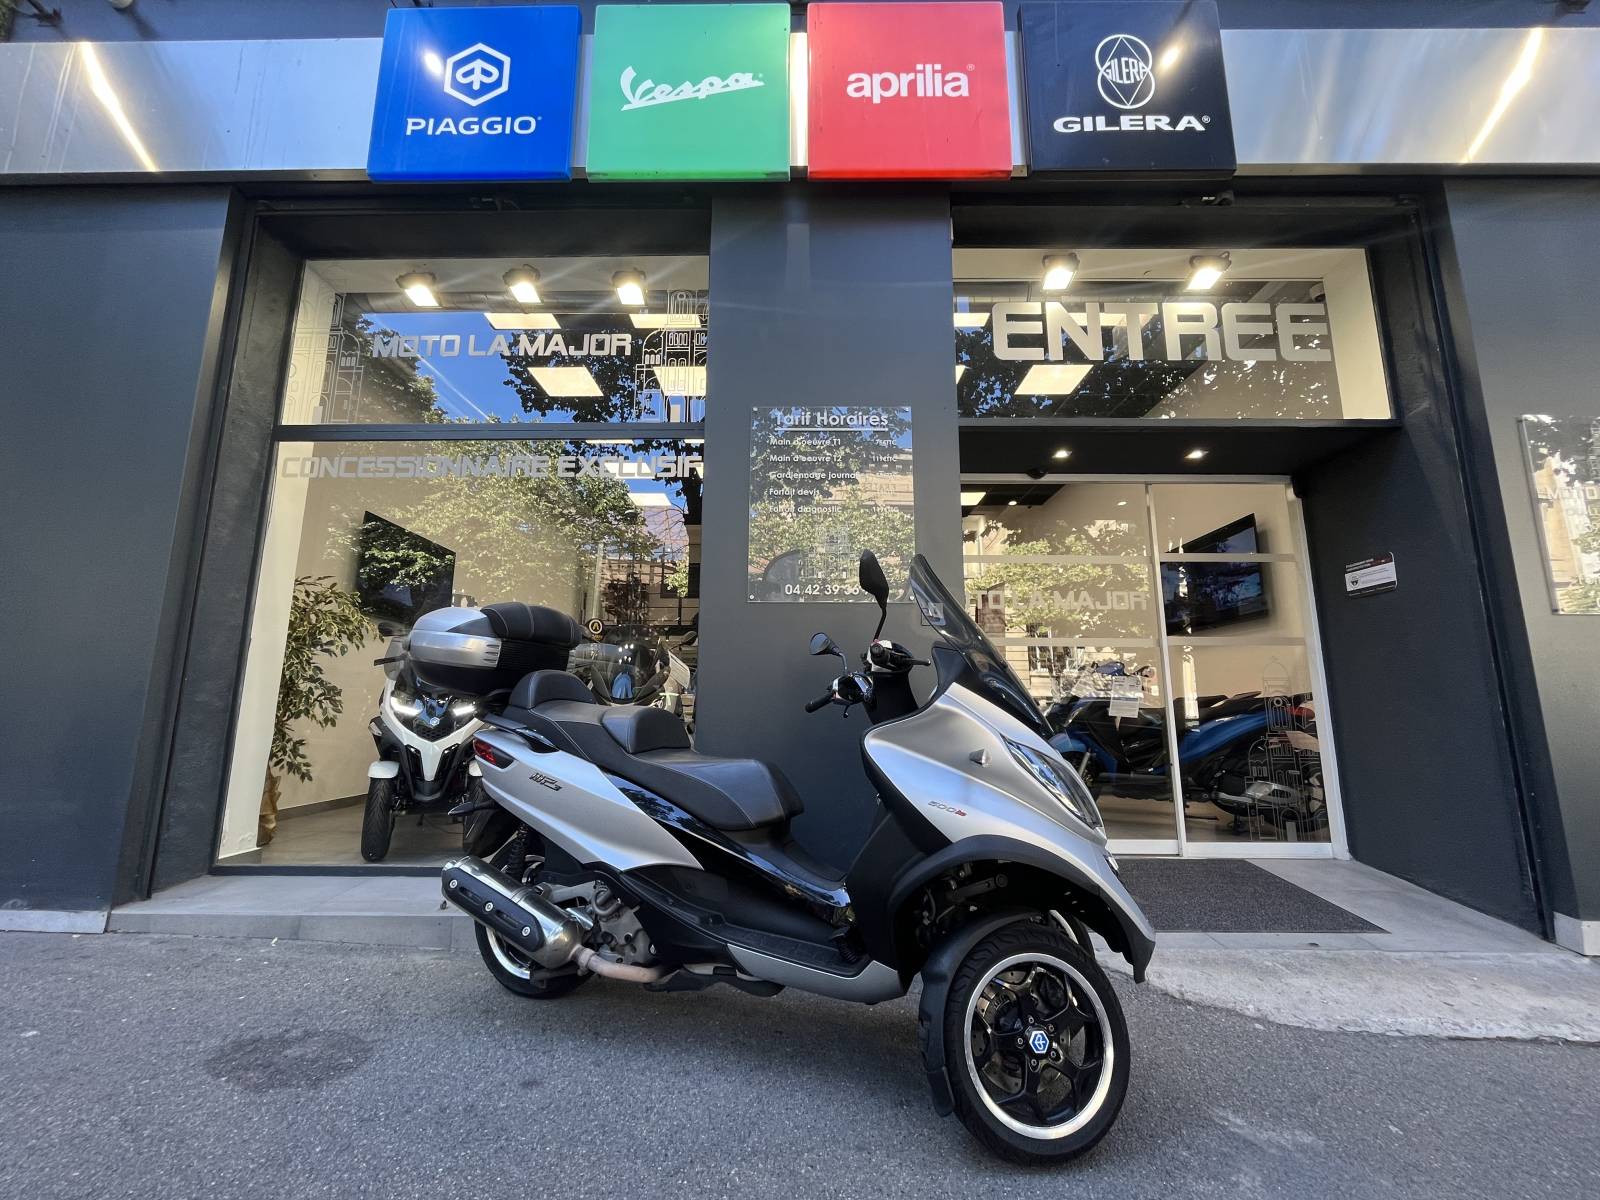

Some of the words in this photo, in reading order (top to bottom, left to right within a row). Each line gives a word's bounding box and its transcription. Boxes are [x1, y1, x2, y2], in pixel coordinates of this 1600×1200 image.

[1103, 56, 1148, 84] GILERA
[620, 66, 765, 111] Vespa
[846, 64, 969, 104] aprilia
[405, 115, 538, 136] PIAGGIO
[1053, 115, 1206, 133] GILERA
[992, 301, 1332, 362] ENTREE
[372, 334, 460, 358] MOTO
[469, 334, 511, 357] LA
[518, 333, 632, 356] MAJOR
[775, 411, 811, 426] Tarif
[817, 411, 889, 426] Horaires
[281, 455, 550, 479] CONCESSIONNAIRE
[557, 455, 703, 478] EXCLUSIF
[769, 454, 791, 462] Main
[797, 487, 820, 496] devis
[785, 584, 801, 595] 04
[804, 584, 820, 595] 42
[824, 584, 840, 595] 39
[1053, 590, 1147, 610] MAJOR
